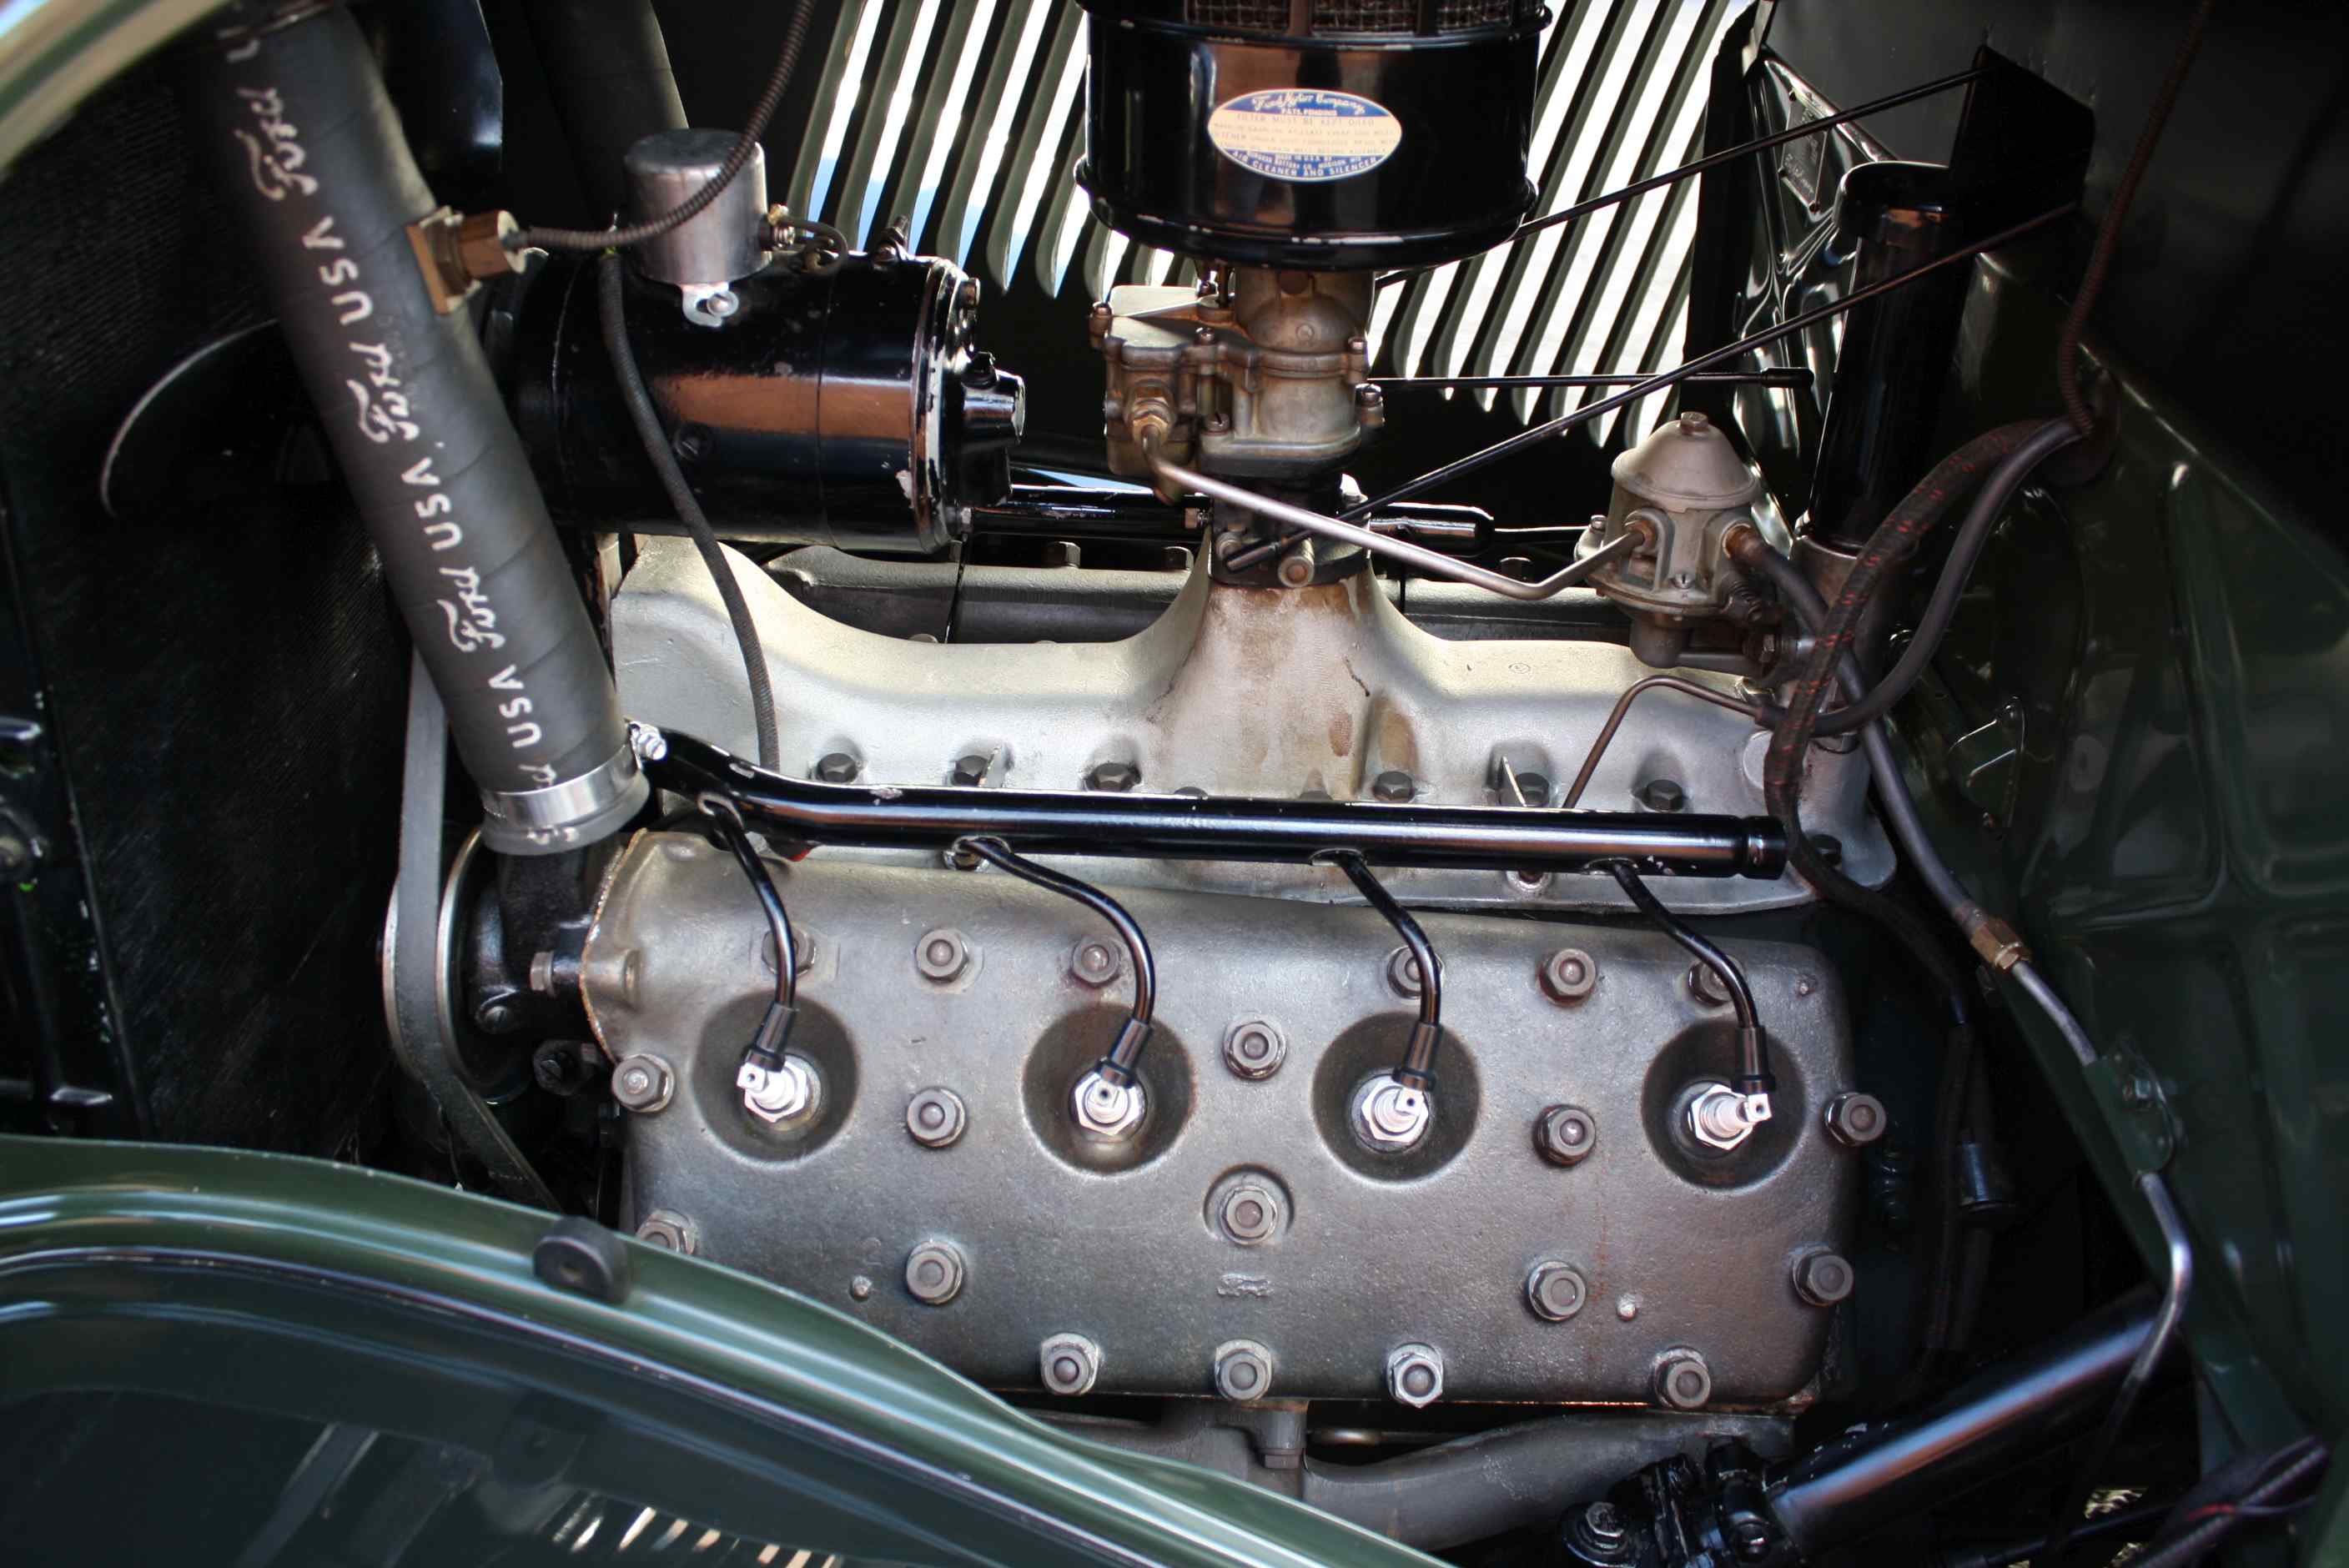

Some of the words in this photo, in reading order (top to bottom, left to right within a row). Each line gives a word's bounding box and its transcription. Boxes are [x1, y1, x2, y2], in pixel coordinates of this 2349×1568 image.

[232, 87, 319, 201] Ford
[1253, 160, 1297, 176] CLEANER
[1303, 168, 1324, 176] AND
[1330, 156, 1377, 175] SILENCER
[302, 215, 373, 326] USA
[346, 341, 420, 443] Ford
[401, 457, 462, 550] USA
[437, 566, 506, 652] Ford
[488, 664, 541, 748] USA
